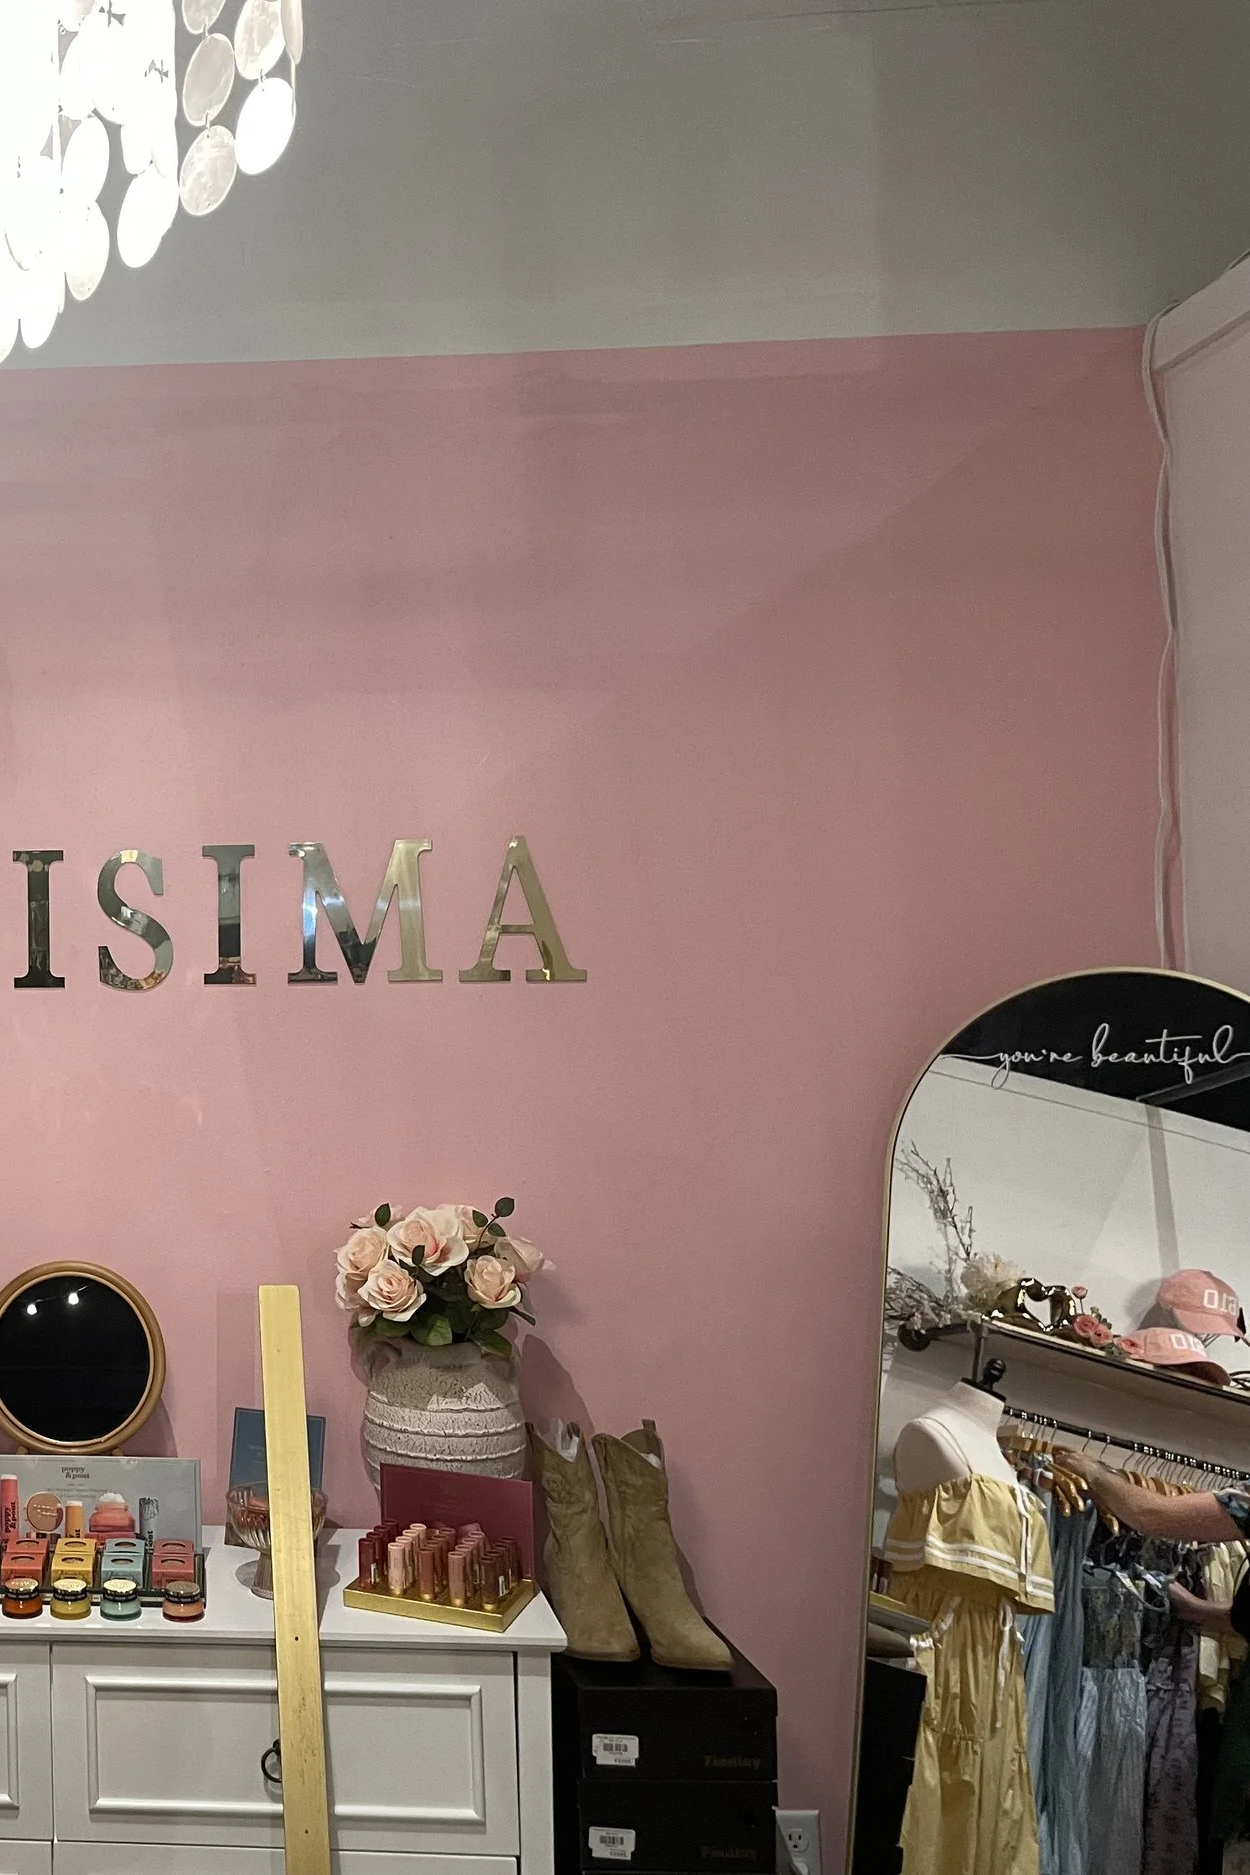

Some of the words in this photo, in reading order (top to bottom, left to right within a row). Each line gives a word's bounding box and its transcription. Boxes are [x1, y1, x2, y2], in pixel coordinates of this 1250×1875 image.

[942, 1048, 1083, 1090] you're
[1091, 1023, 1250, 1085] beautiful
[72, 1472, 90, 1480] pout
